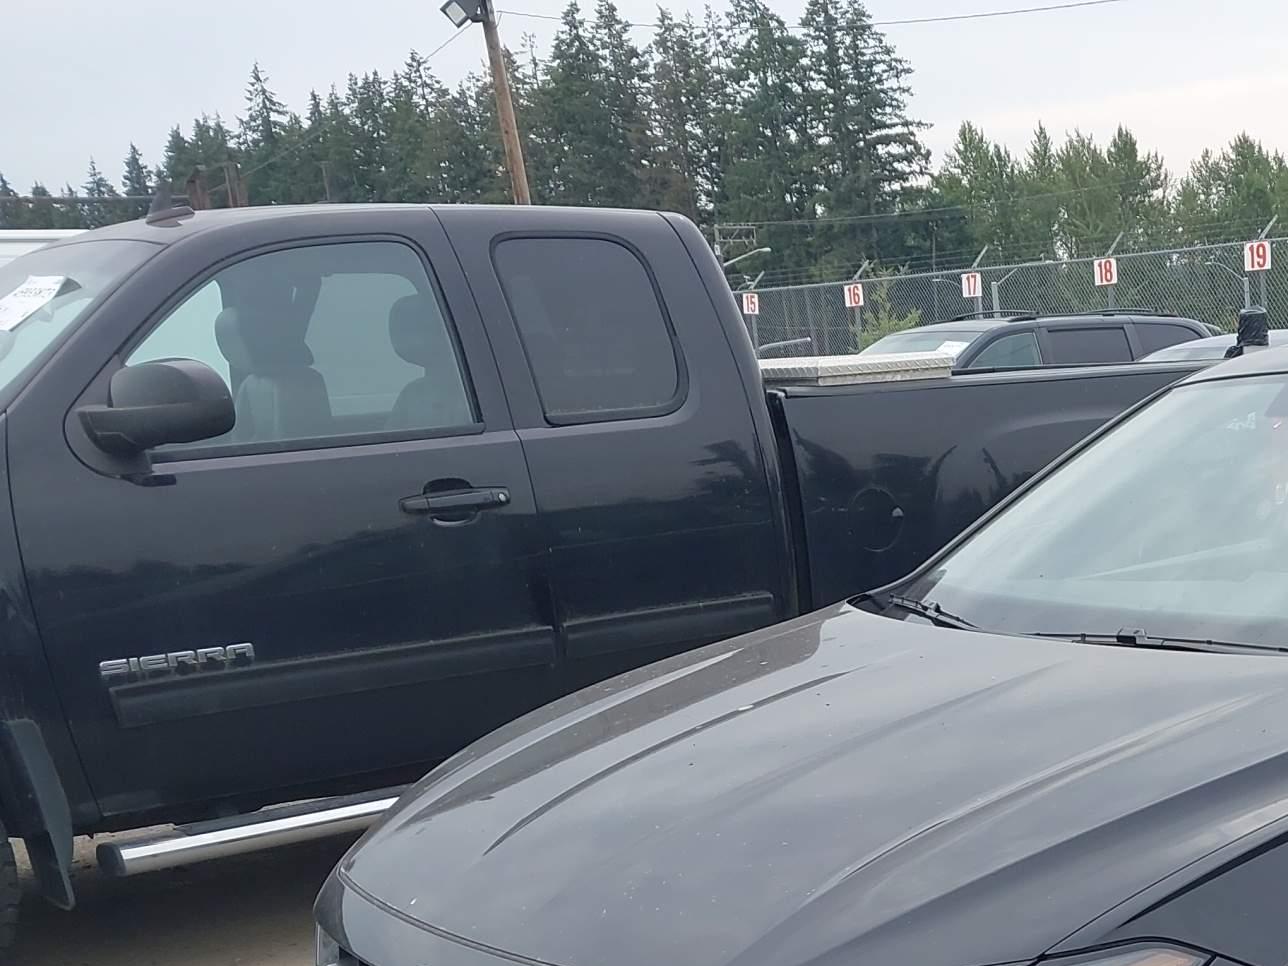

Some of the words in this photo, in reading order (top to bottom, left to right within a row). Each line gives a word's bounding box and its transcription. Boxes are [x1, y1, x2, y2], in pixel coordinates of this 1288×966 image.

[1248, 243, 1267, 269] 19
[1097, 259, 1113, 284] 18
[847, 285, 860, 305] 16
[965, 274, 977, 296] 17
[745, 294, 757, 313] 15
[99, 642, 255, 676] SIERRA
